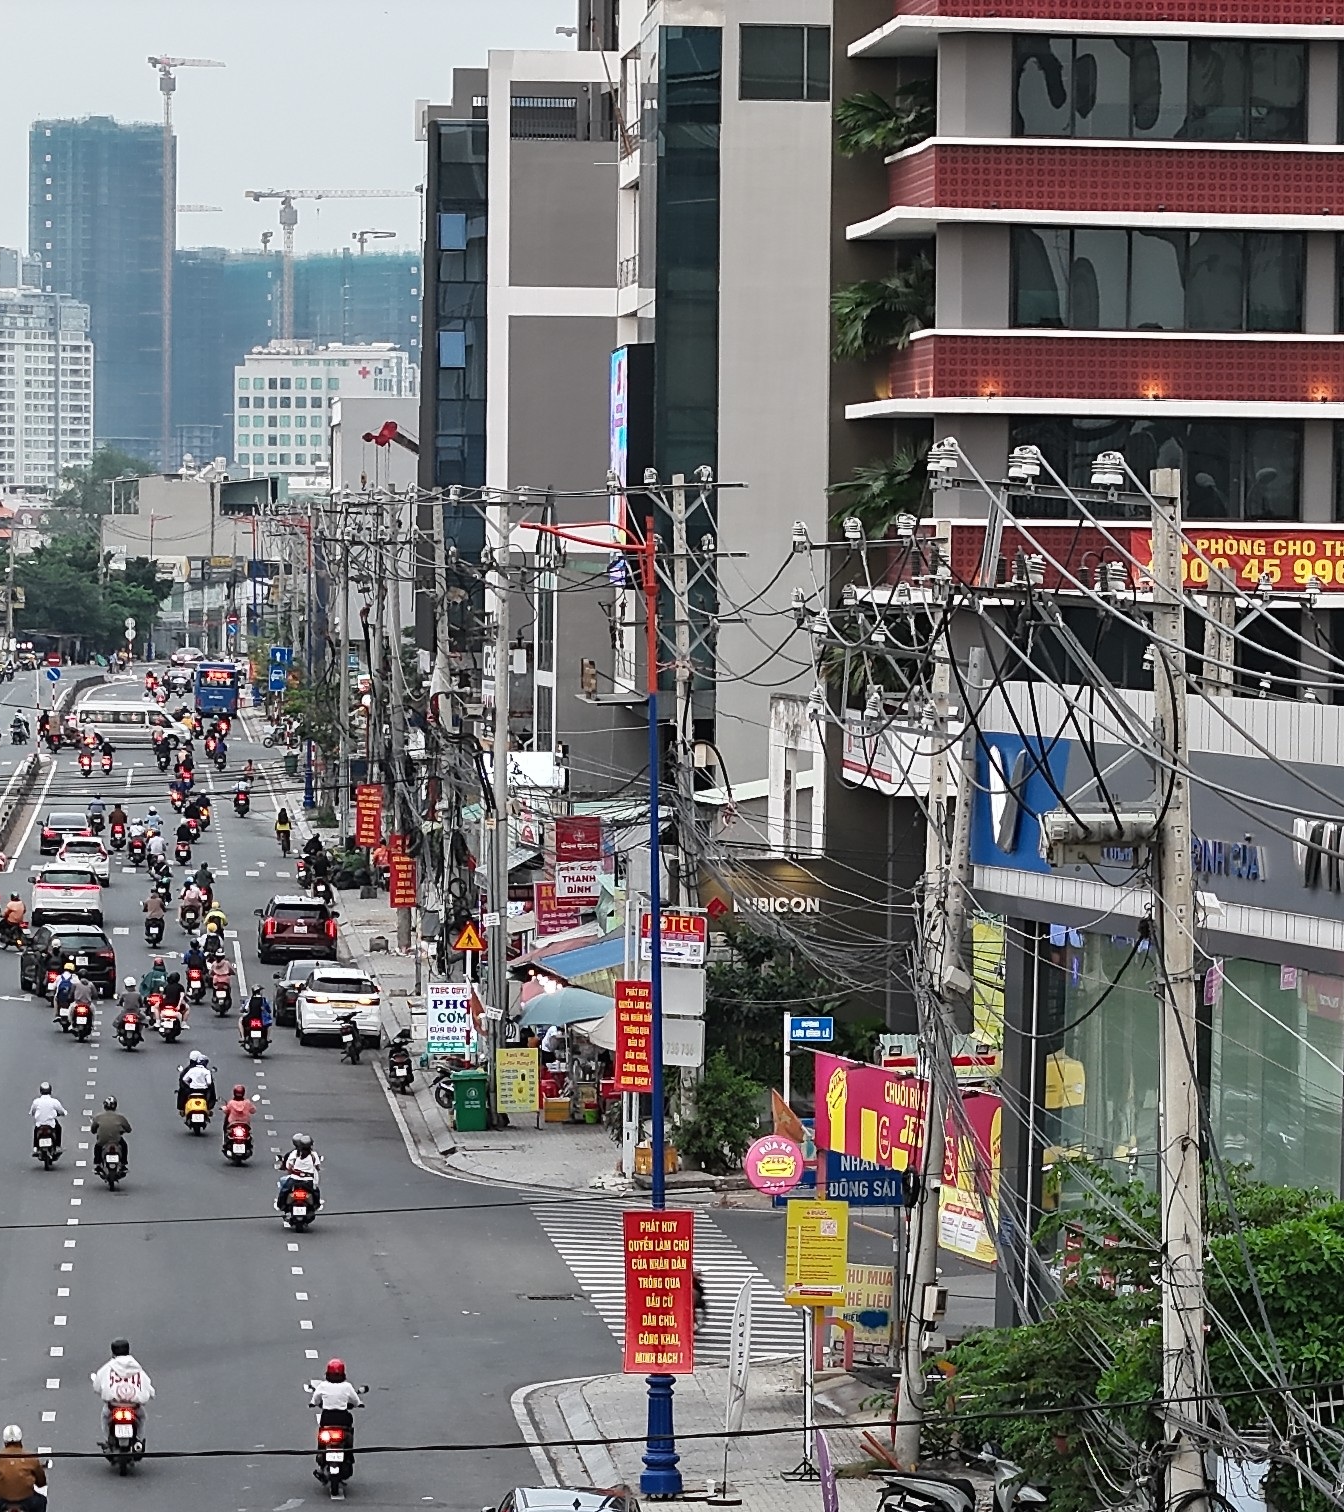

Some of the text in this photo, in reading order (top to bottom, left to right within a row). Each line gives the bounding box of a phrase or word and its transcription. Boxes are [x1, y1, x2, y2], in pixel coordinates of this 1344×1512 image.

[1148, 538, 1190, 555] VN
[1197, 536, 1265, 556] PHÒNG
[1274, 541, 1316, 556] CHO
[1242, 558, 1281, 583] 45
[562, 875, 596, 883] THANH
[639, 1218, 677, 1233] PHÁT HUY
[655, 1237, 671, 1251] LÀM
[673, 1236, 690, 1252] CHỦ
[638, 1276, 681, 1289] THÔNG QUA
[866, 1271, 894, 1287] MUA
[634, 1351, 656, 1364] MINH
